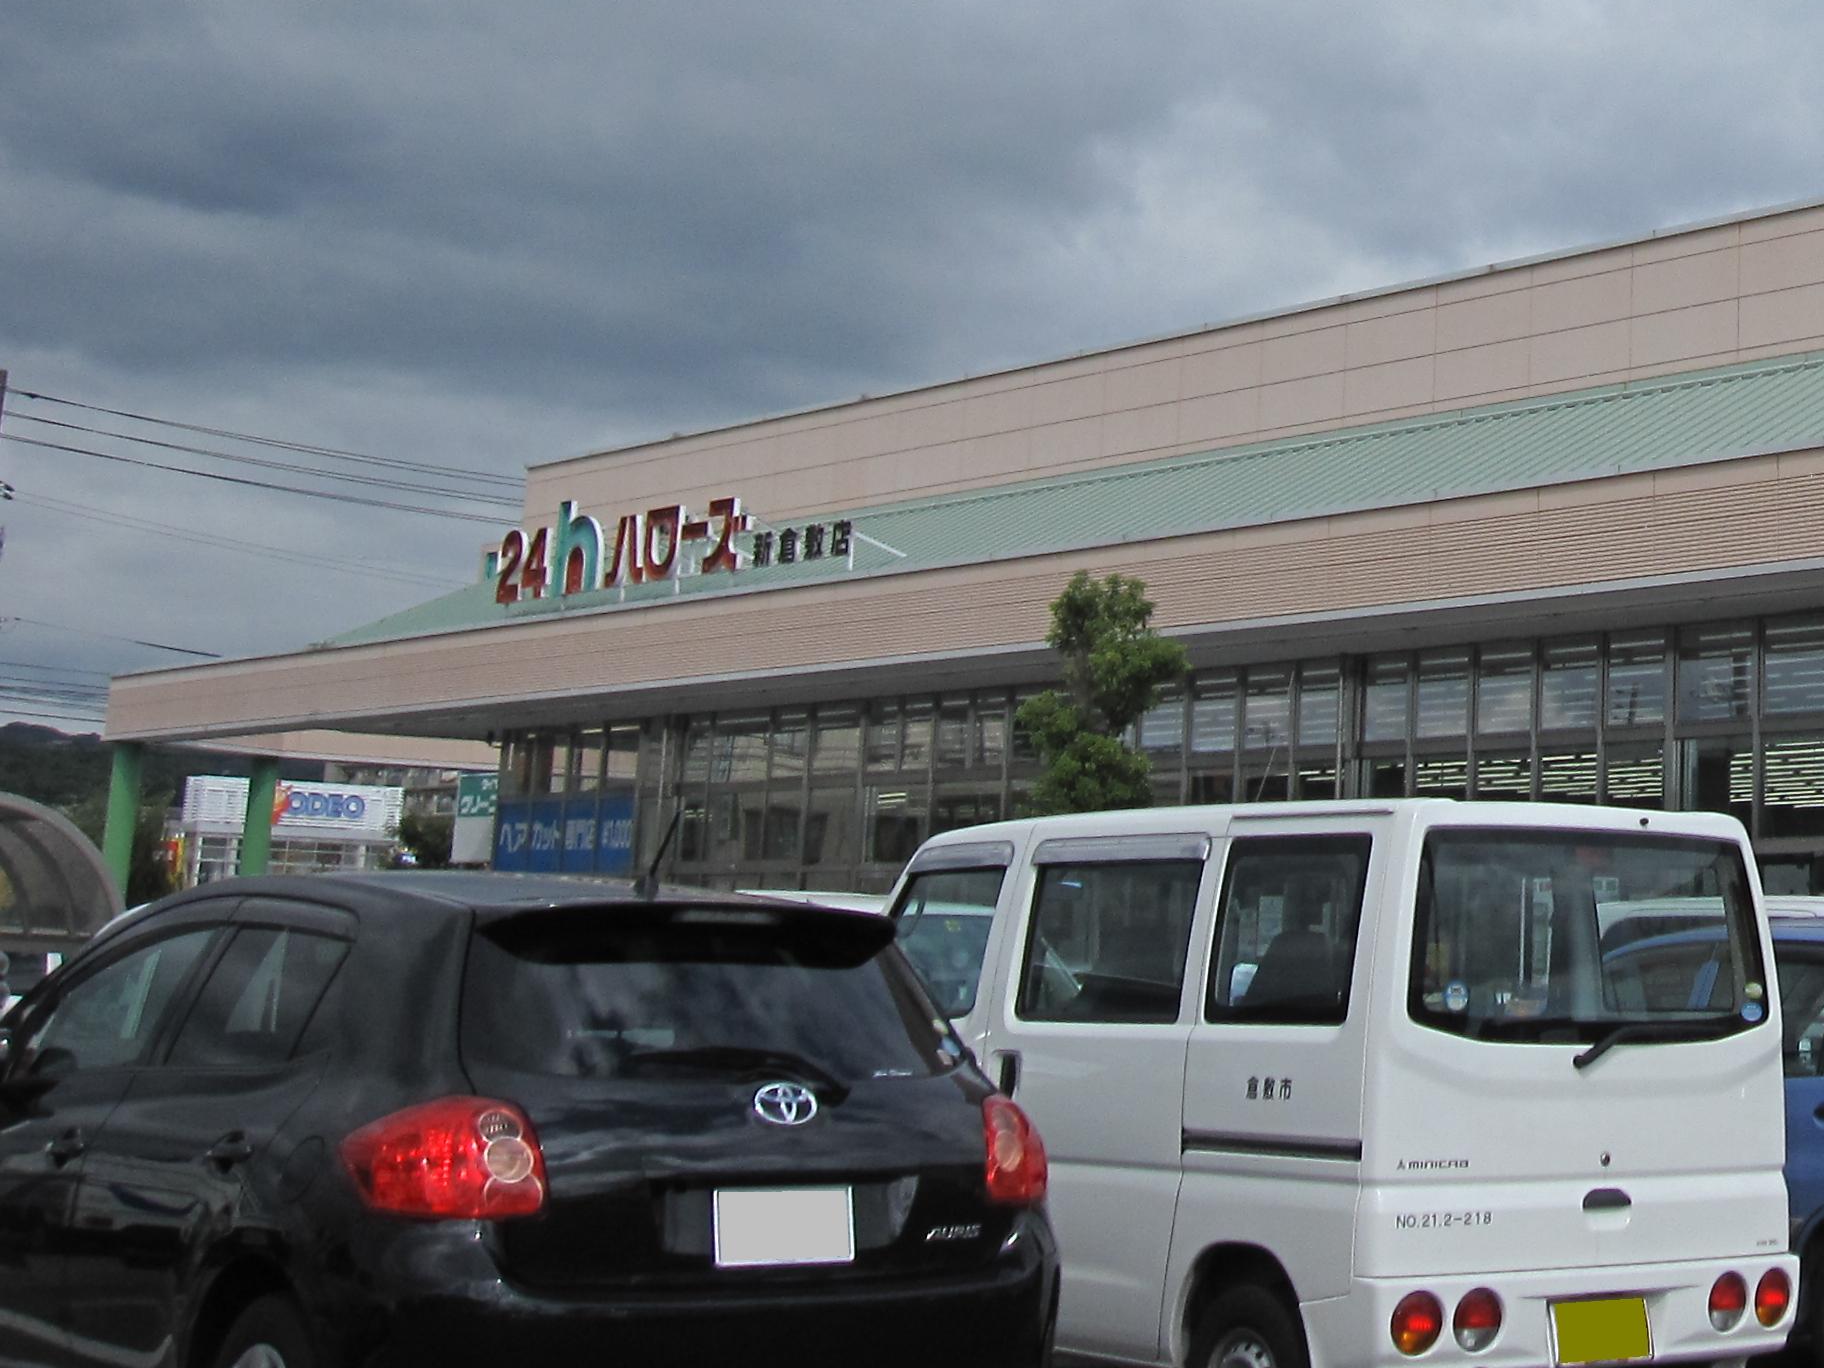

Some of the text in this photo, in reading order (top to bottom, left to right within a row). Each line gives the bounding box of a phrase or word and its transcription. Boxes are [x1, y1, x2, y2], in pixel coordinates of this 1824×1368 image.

[604, 496, 755, 587] ハローズ
[752, 520, 853, 568] 新倉敷店
[500, 822, 529, 853] ヘア
[531, 820, 560, 850] カット
[1246, 1076, 1293, 1100] 倉敷市
[1396, 1211, 1492, 1229] NO.21.2-218
